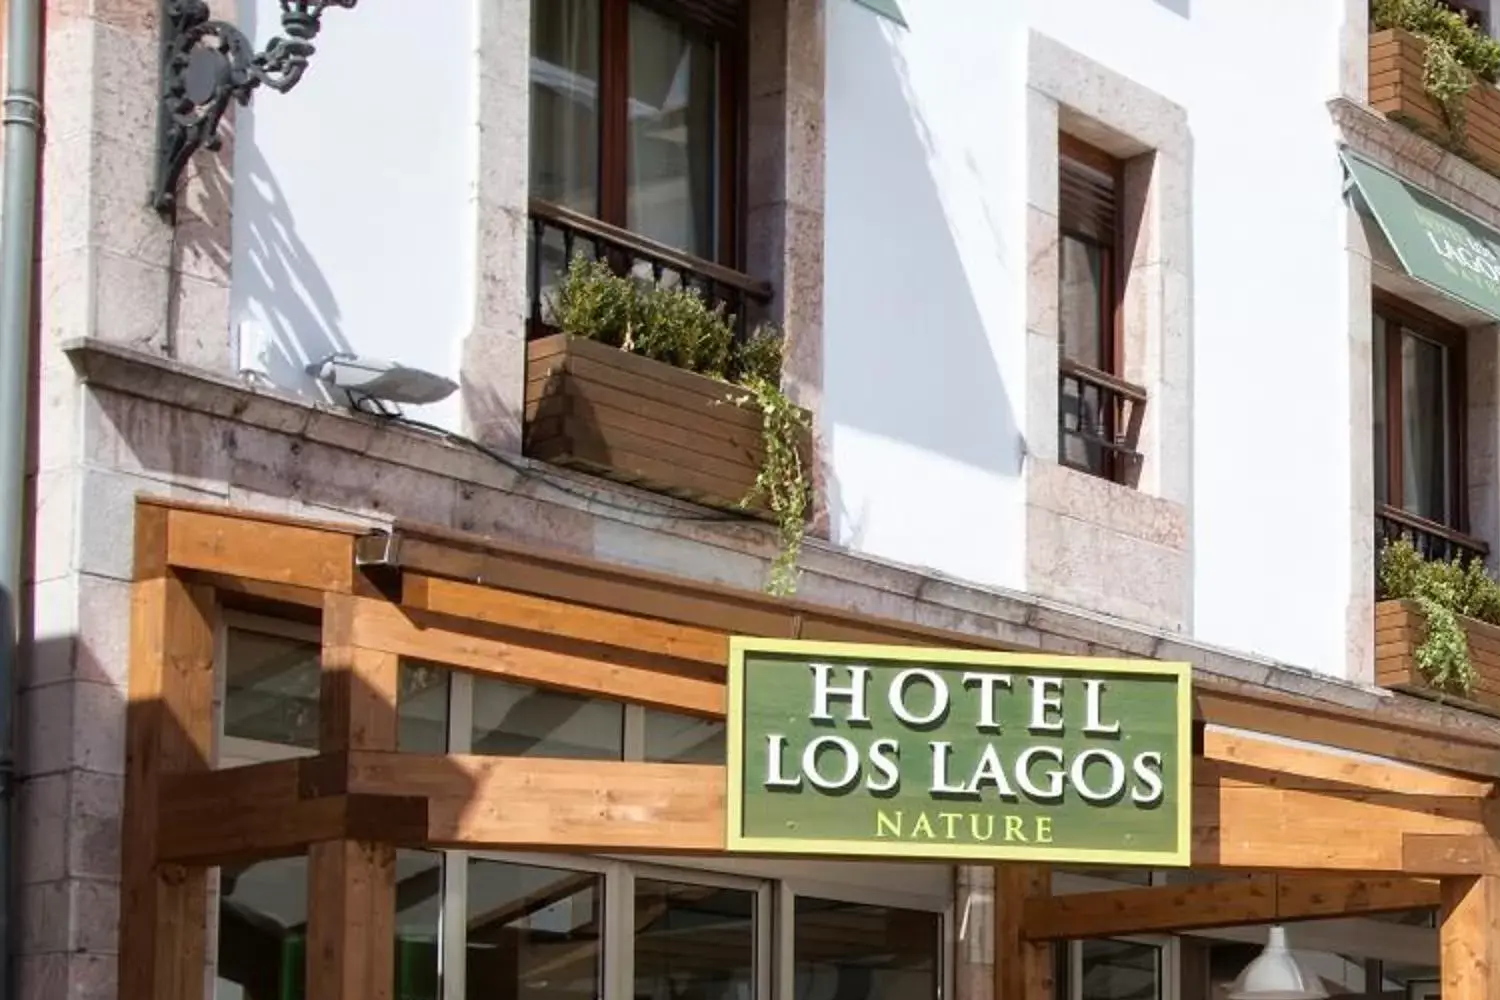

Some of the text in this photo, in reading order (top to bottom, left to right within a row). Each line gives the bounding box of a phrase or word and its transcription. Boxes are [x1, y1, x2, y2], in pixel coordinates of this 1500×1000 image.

[809, 663, 1120, 734] HOTEL
[765, 735, 1164, 804] LOS LAGOS
[876, 810, 1053, 843] NATURE
